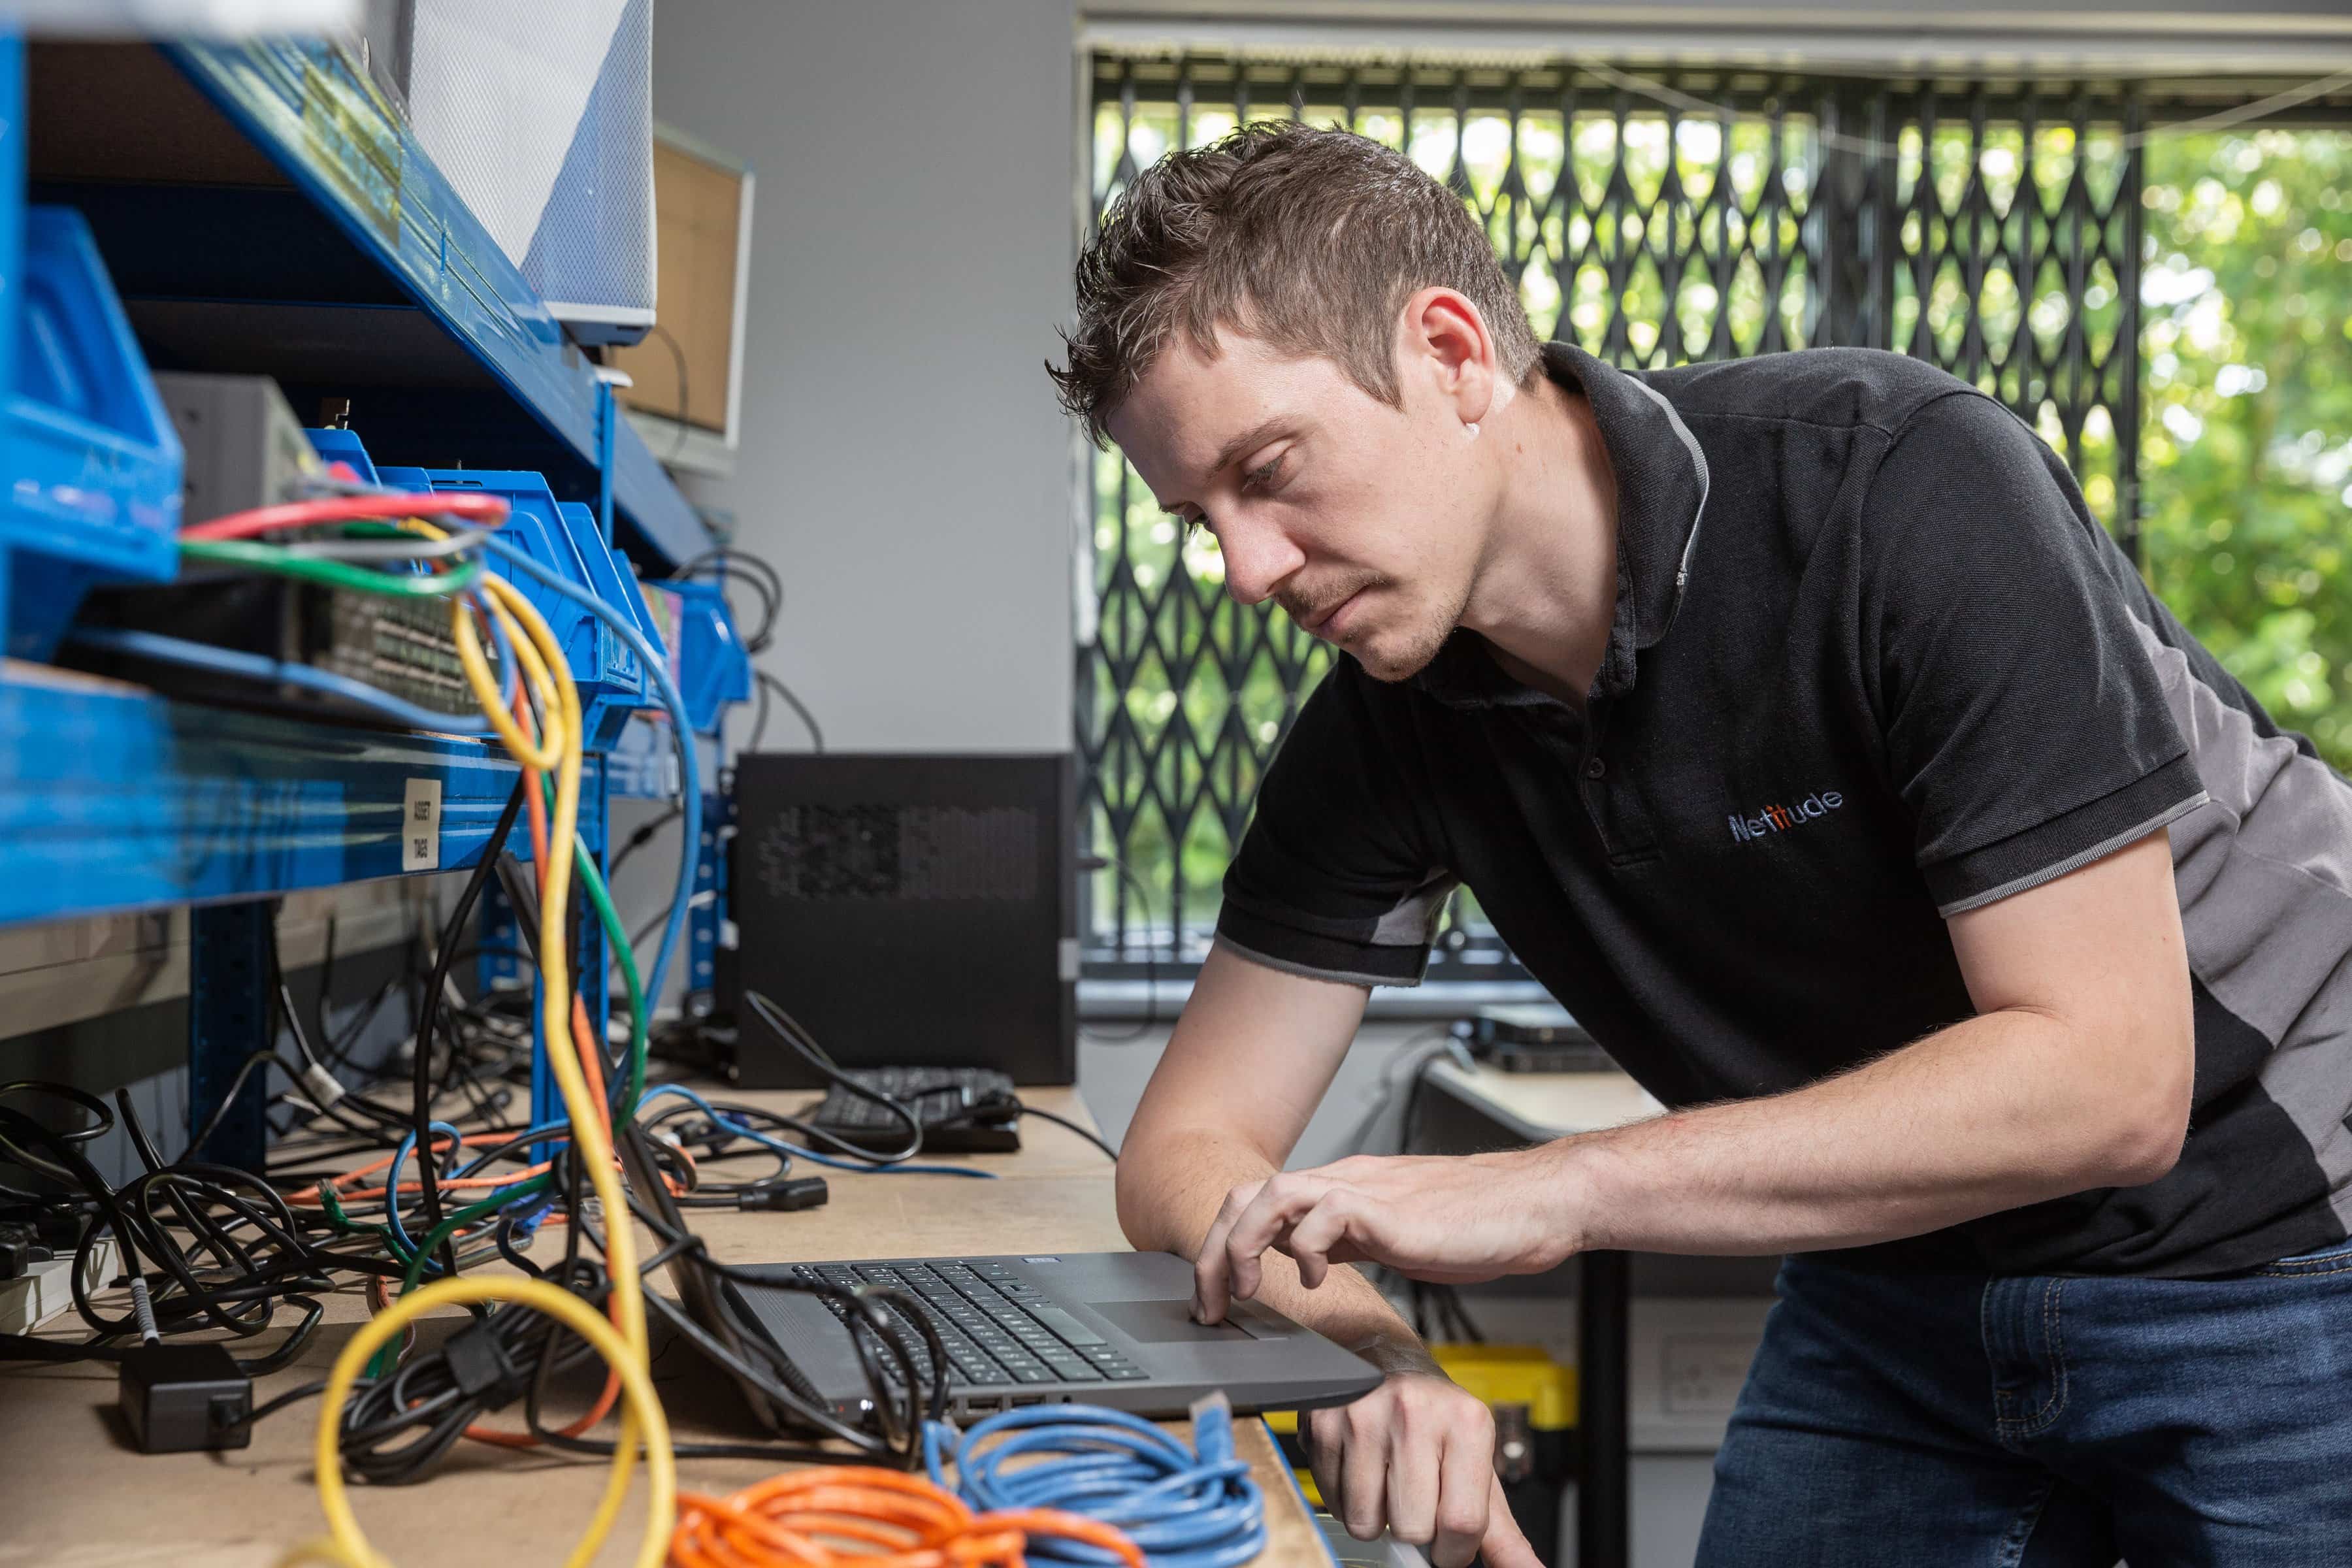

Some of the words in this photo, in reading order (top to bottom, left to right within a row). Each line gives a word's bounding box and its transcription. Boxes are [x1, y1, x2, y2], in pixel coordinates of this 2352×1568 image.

[414, 801, 431, 821] ASSET
[1728, 791, 1842, 842] Netitude
[414, 838, 427, 858] TAGS
